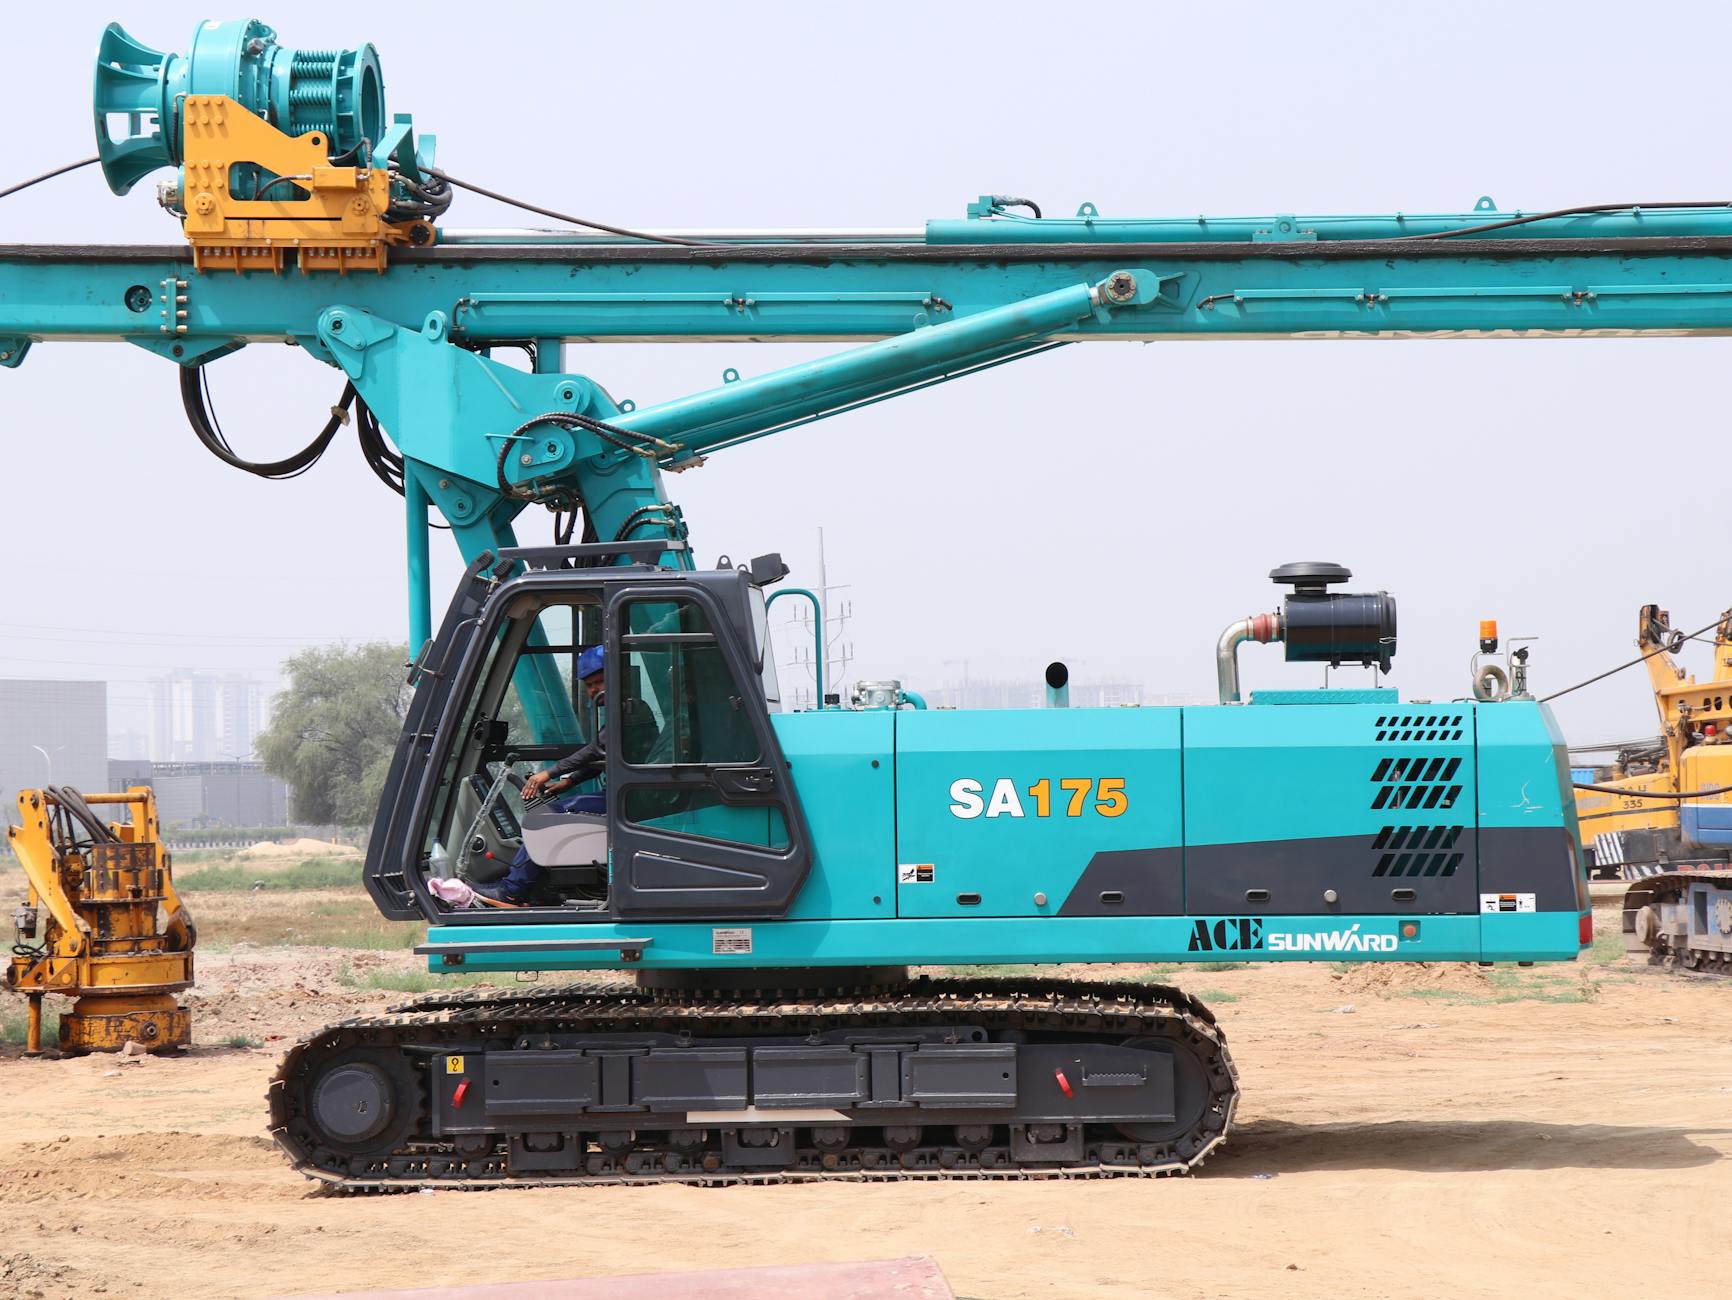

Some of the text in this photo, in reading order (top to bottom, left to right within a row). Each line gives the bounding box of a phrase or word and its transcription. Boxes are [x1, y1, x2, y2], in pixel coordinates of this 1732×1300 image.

[949, 778, 1129, 819] SA175
[1623, 799, 1643, 809] 335
[1188, 918, 1399, 951] ACE SUNWARD
